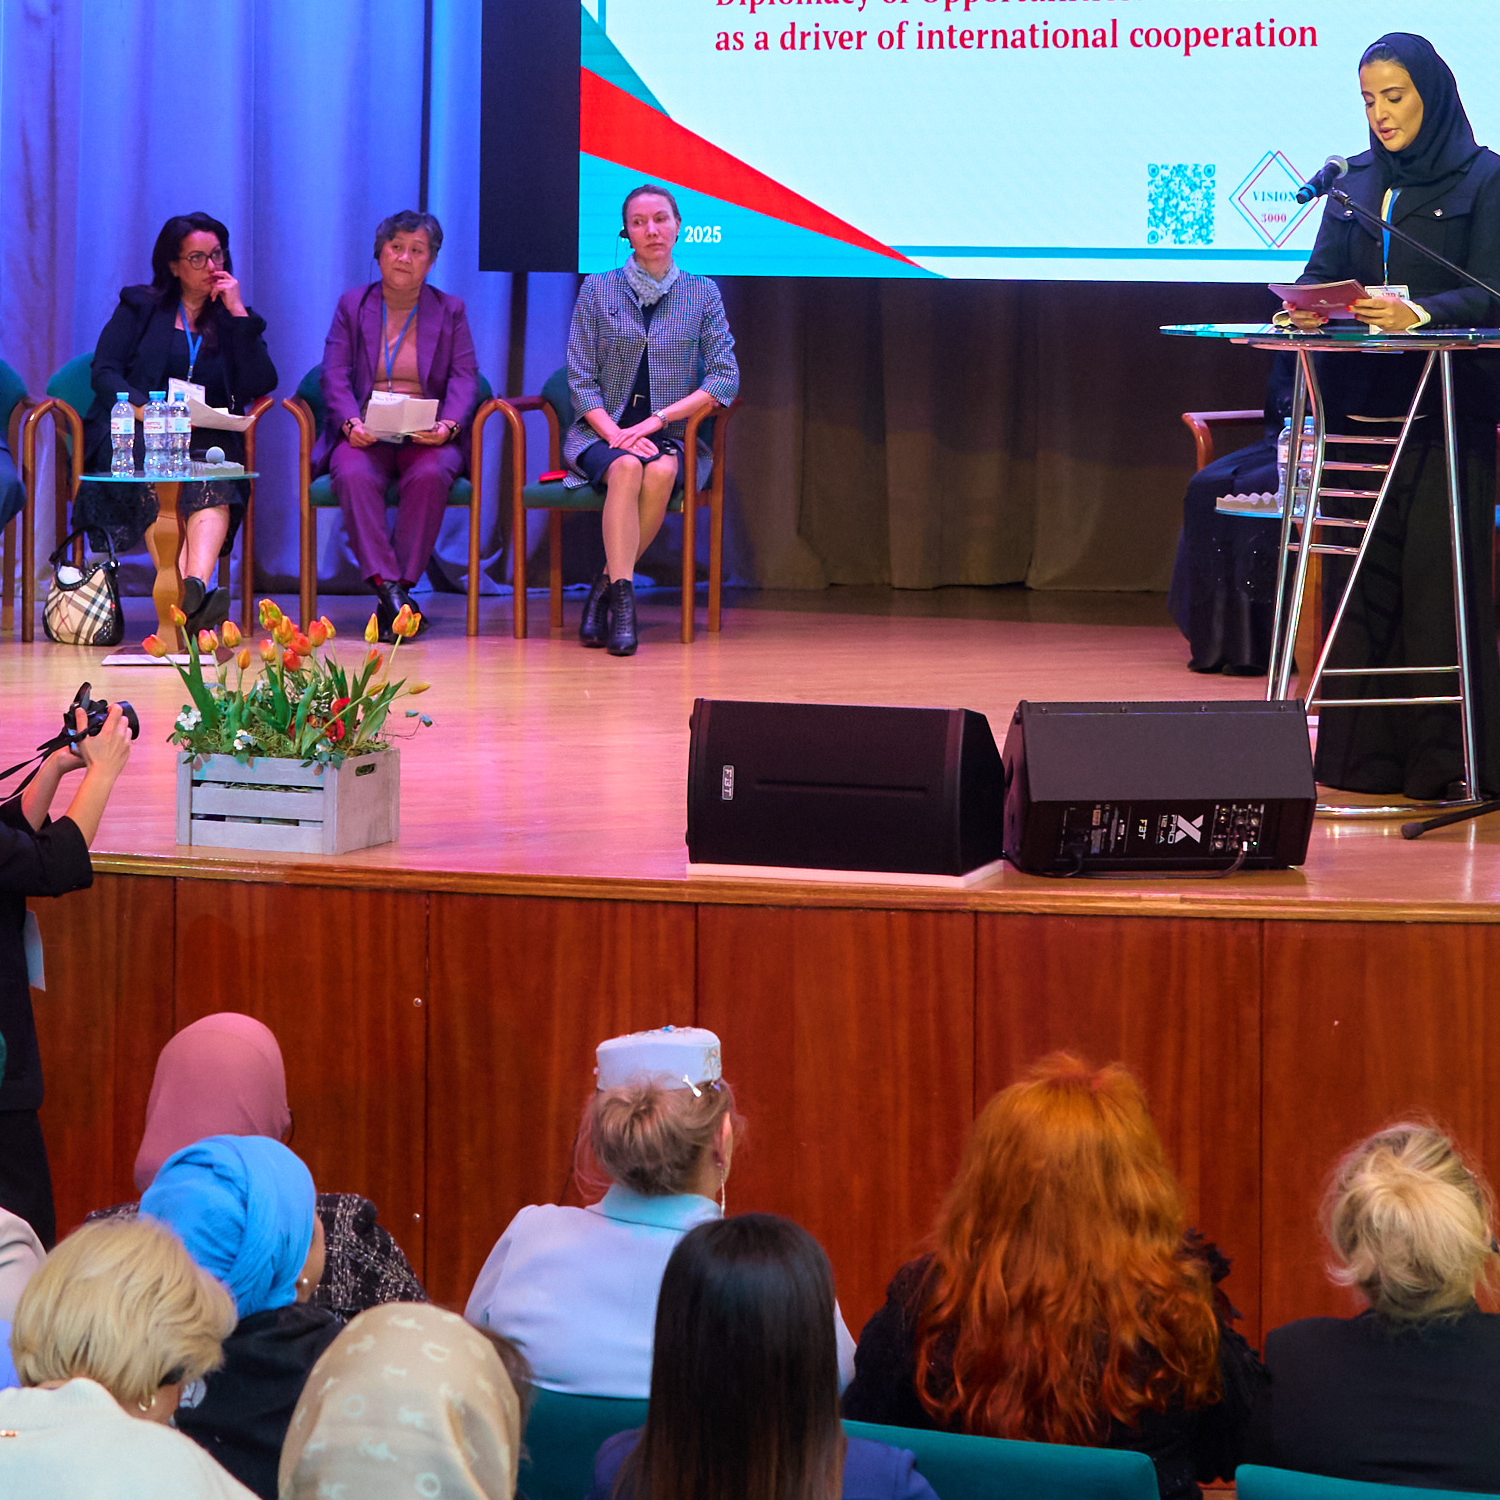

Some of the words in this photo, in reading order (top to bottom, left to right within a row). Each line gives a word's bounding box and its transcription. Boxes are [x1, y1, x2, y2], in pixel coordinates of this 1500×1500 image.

[715, 31, 745, 52] as
[753, 31, 770, 51] a
[779, 21, 868, 51] driver
[877, 20, 910, 50] of
[916, 18, 1119, 50] international
[1129, 17, 1318, 57] cooperation
[1252, 191, 1297, 202] VISION
[684, 225, 722, 243] 2025
[723, 767, 733, 798] FBT
[1137, 819, 1148, 840] FBT
[1167, 814, 1178, 844] PRO
